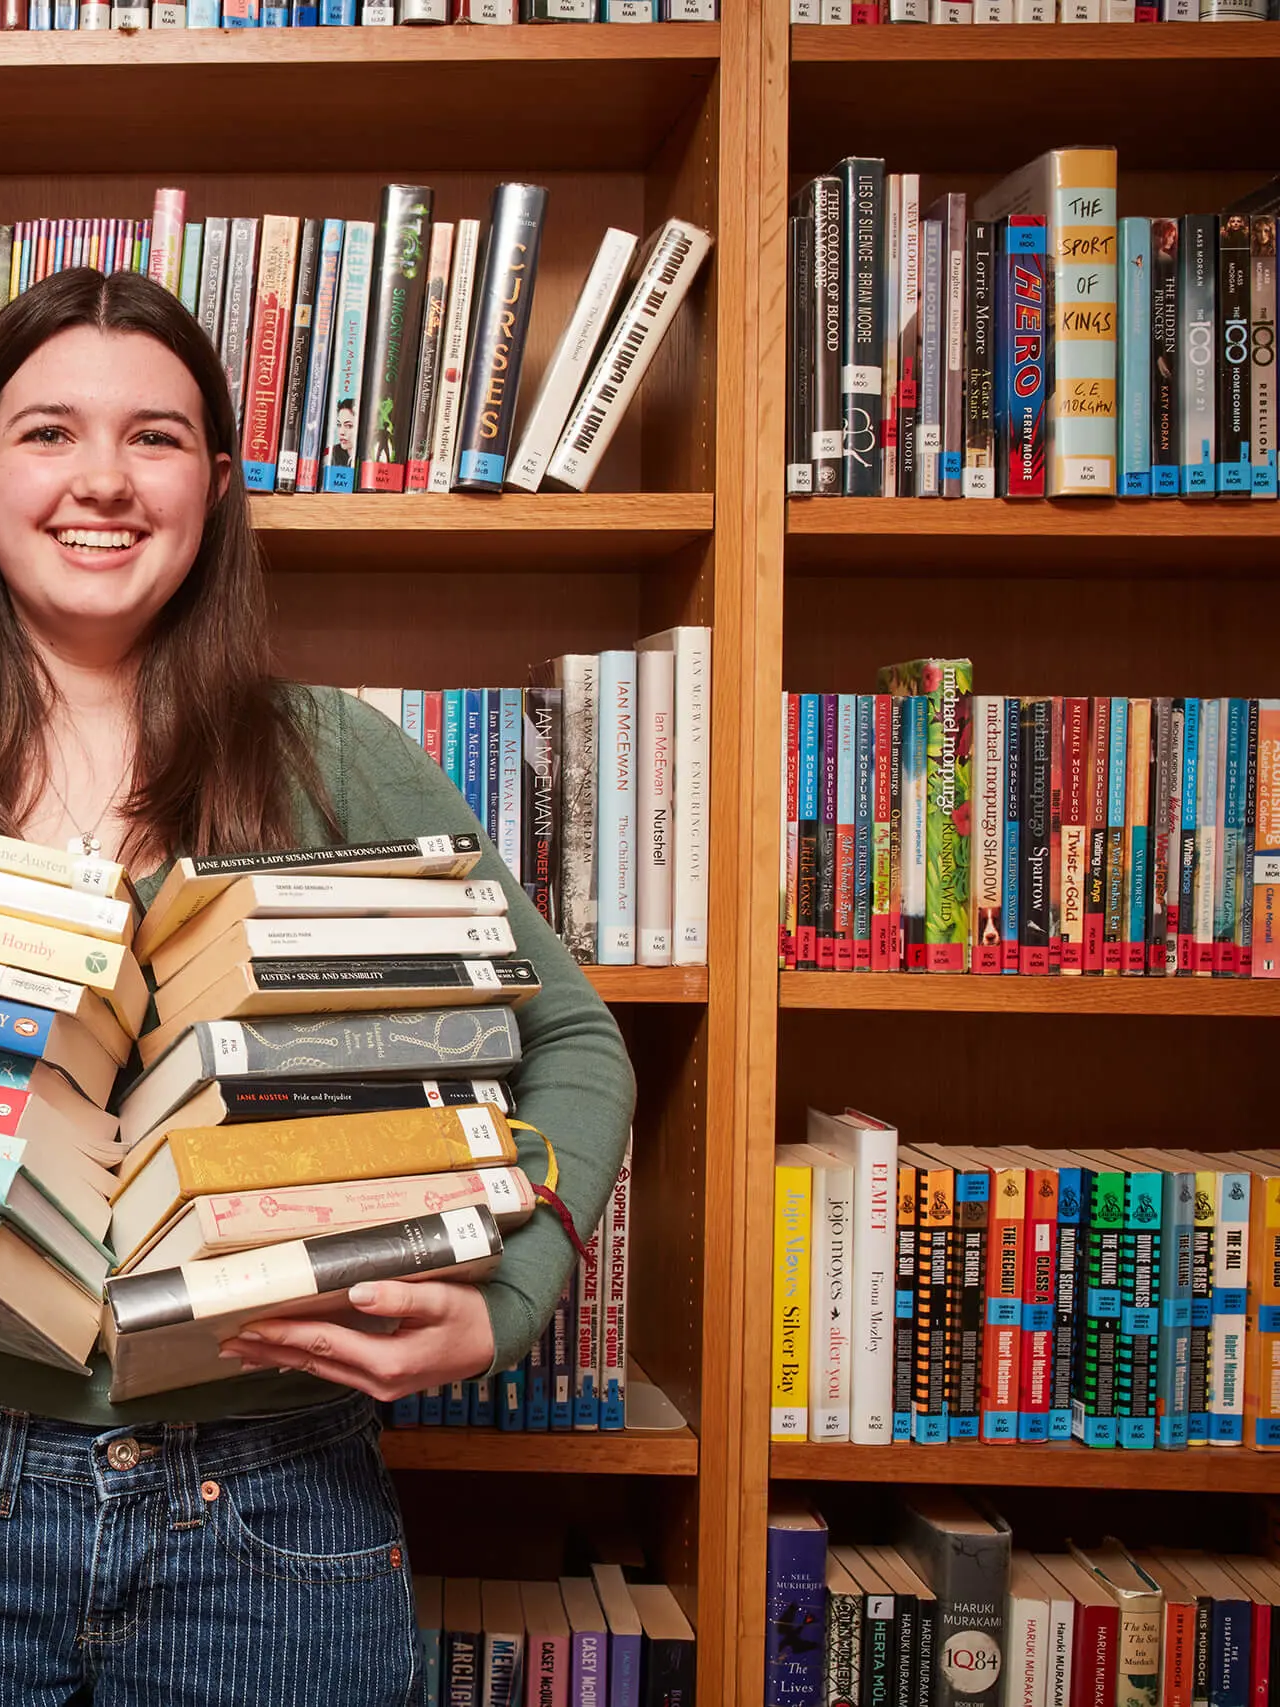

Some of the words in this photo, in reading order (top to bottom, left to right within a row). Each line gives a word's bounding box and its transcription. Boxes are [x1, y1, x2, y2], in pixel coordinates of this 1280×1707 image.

[858, 176, 871, 197] LIES
[858, 201, 871, 215] OF
[1069, 198, 1103, 216] THE
[858, 219, 871, 261] SILENCE
[1061, 237, 1114, 256] SPORT
[858, 272, 871, 302] BRIAN
[976, 252, 988, 299] Lorrie
[1077, 276, 1099, 294] OF
[858, 306, 871, 342] MOORE
[976, 305, 988, 354] Moore
[1015, 267, 1042, 397] HERO
[1061, 312, 1112, 332] KINGS
[479, 244, 526, 438] CURSES
[1060, 398, 1113, 414] MORGAN
[1023, 407, 1033, 440] PERRY
[1023, 444, 1033, 480] MOORE
[943, 666, 956, 734] michael
[535, 708, 553, 741] IAN
[534, 747, 553, 836] McEWAN
[936, 738, 956, 816] morpurgo
[653, 809, 667, 866] Nutshell
[18, 844, 69, 875] Austen
[197, 859, 221, 871] JANE
[222, 857, 255, 869] AUSTEN
[261, 854, 284, 865] LADY
[1028, 847, 1048, 911] Sparrow
[3, 933, 56, 962] Hornby
[260, 972, 291, 983] AUSTEN
[297, 971, 319, 981] SENSE
[322, 971, 339, 981] AND
[341, 970, 384, 981] SENSIBILITY
[236, 1093, 262, 1101] JANE
[264, 1092, 289, 1101] AUSTEN
[293, 1092, 311, 1101] Pride
[313, 1093, 323, 1101] and
[324, 1092, 352, 1102] Prejudice
[474, 1126, 483, 1141] FIC
[482, 1123, 491, 1140] AUS
[613, 1185, 626, 1231] SOPHIE
[871, 1163, 887, 1234] ELMET
[828, 1199, 848, 1235] jojo
[611, 1236, 626, 1301] McKENZIE
[831, 1239, 846, 1300] moyes
[607, 1307, 617, 1325] HIT
[782, 1306, 800, 1358] Silver
[606, 1328, 617, 1368] SQUAD
[828, 1327, 848, 1365] after
[783, 1362, 799, 1396] Bay
[827, 1369, 840, 1400] you
[943, 1615, 1002, 1627] MURAKAMI
[954, 1603, 995, 1614] HARUKI
[787, 1662, 808, 1674] The
[945, 1649, 998, 1671] 1Q84
[781, 1681, 813, 1693] Lives
